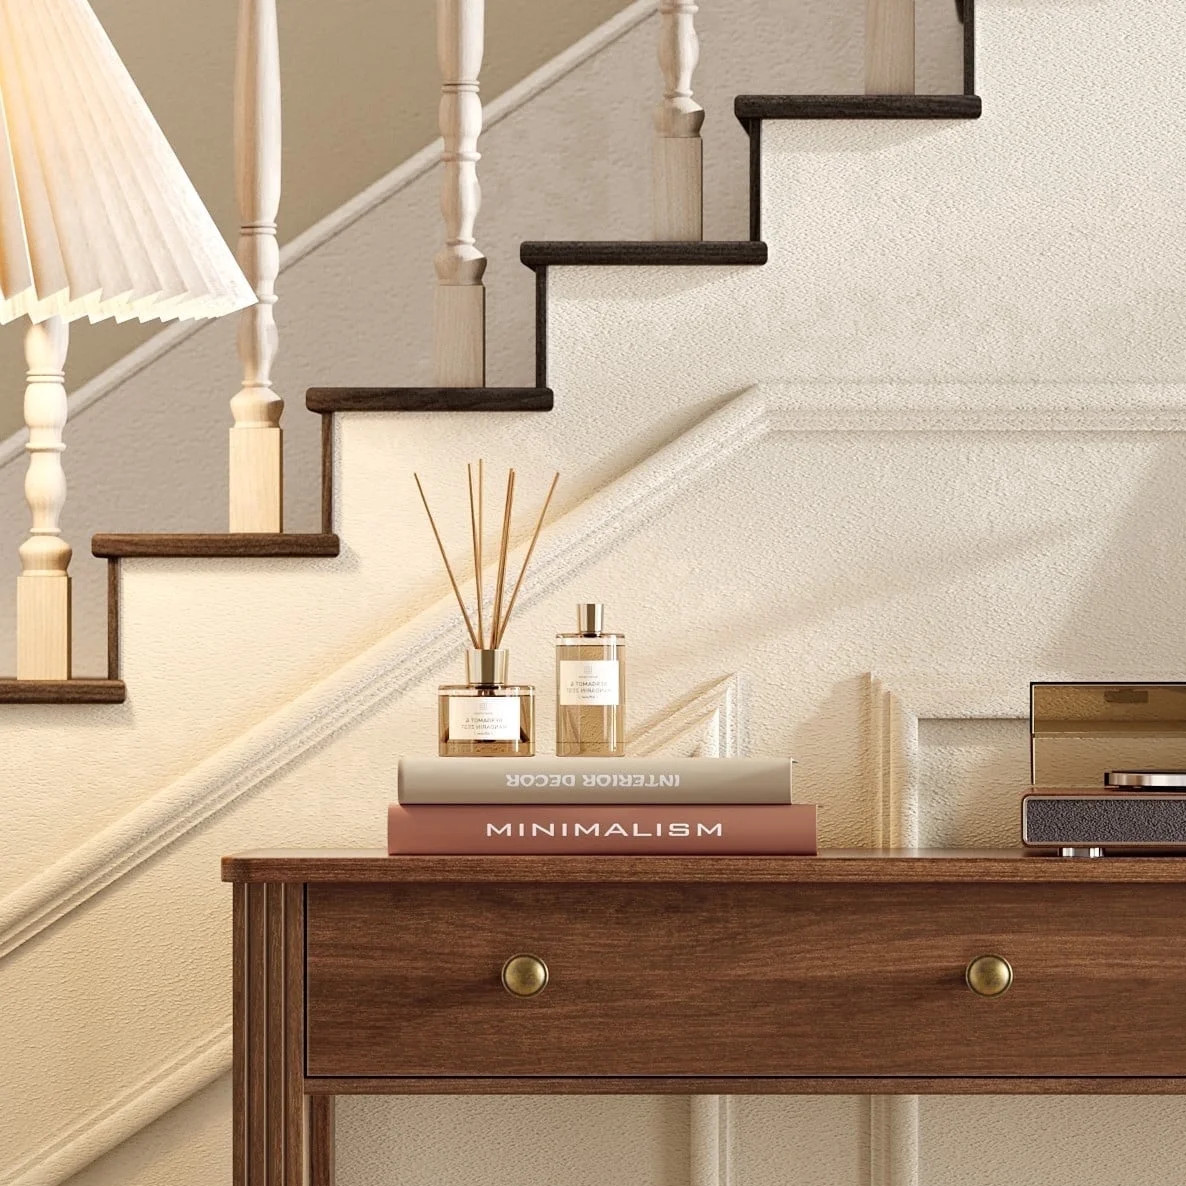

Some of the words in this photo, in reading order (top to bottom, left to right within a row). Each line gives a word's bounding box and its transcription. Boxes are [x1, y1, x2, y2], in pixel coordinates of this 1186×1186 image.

[505, 774, 576, 787] DECOR
[582, 774, 680, 787] INTERIOR
[486, 823, 722, 837] MINIMALISM
